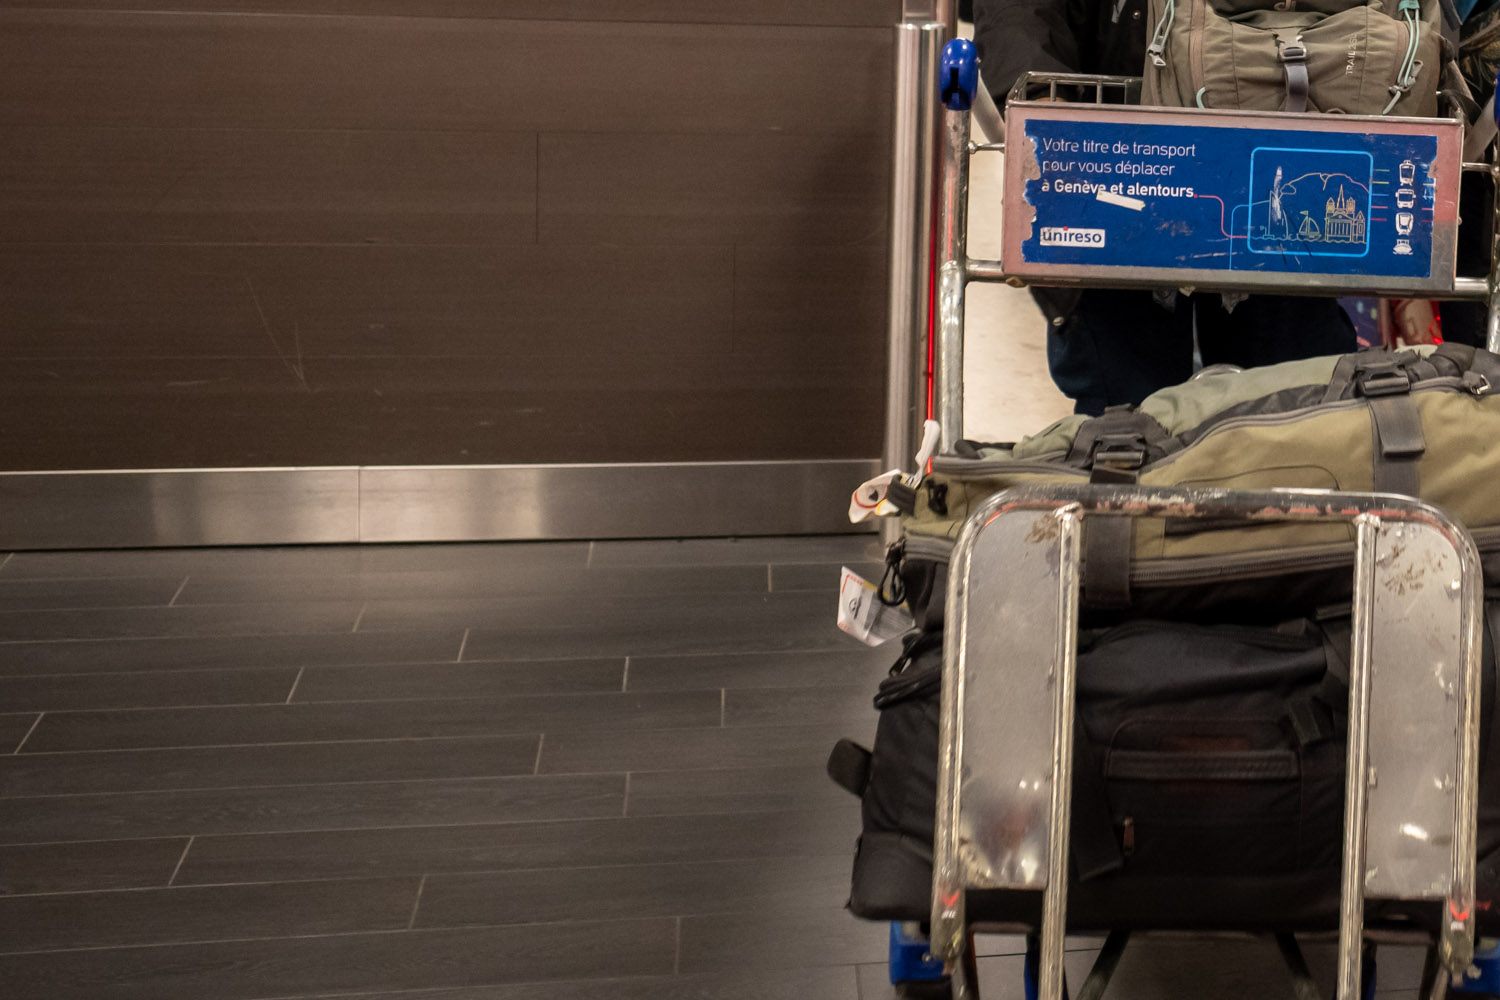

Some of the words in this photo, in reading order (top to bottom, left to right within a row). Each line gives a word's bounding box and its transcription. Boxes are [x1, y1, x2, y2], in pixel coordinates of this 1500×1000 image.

[1345, 51, 1356, 76] TRAIL
[1043, 137, 1079, 152] Votre
[1083, 139, 1109, 153] titre
[1112, 141, 1129, 155] de
[1133, 142, 1196, 159] transport
[1042, 160, 1076, 174] pour
[1078, 163, 1112, 174] vous
[1115, 161, 1175, 177] déplacer
[1041, 179, 1050, 192] à
[1054, 179, 1106, 194] Genève
[1110, 183, 1124, 195] et
[1042, 226, 1102, 243] unireso
